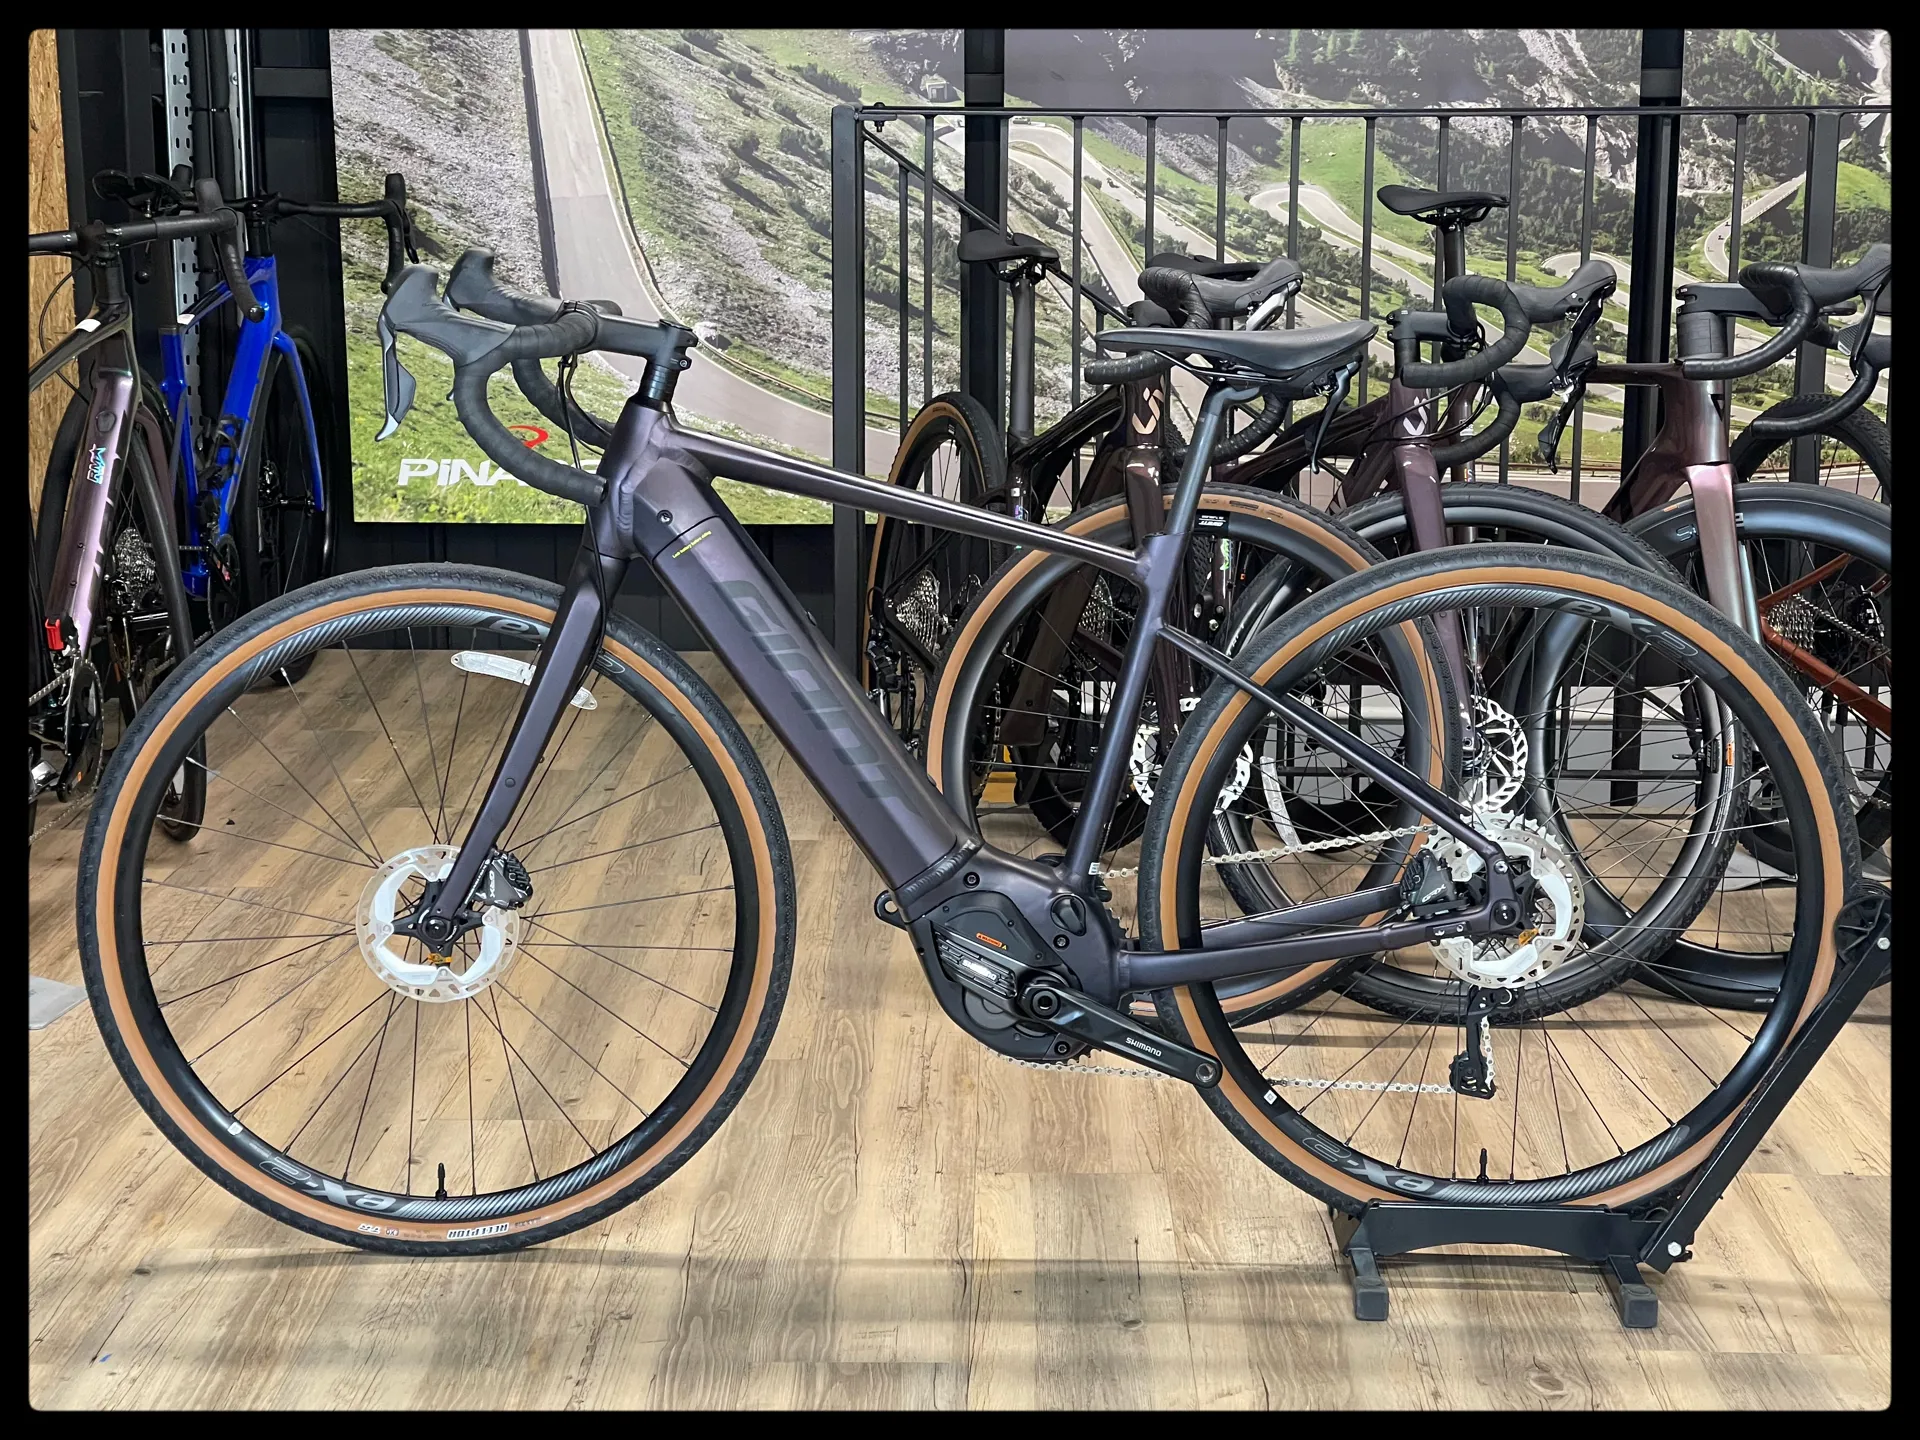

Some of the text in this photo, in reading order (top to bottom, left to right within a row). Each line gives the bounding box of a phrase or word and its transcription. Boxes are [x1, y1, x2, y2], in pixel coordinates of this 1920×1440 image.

[1421, 883, 1446, 903] GRX
[1125, 1036, 1163, 1057] SHIMANO
[447, 1223, 509, 1240] RECEPTOR
